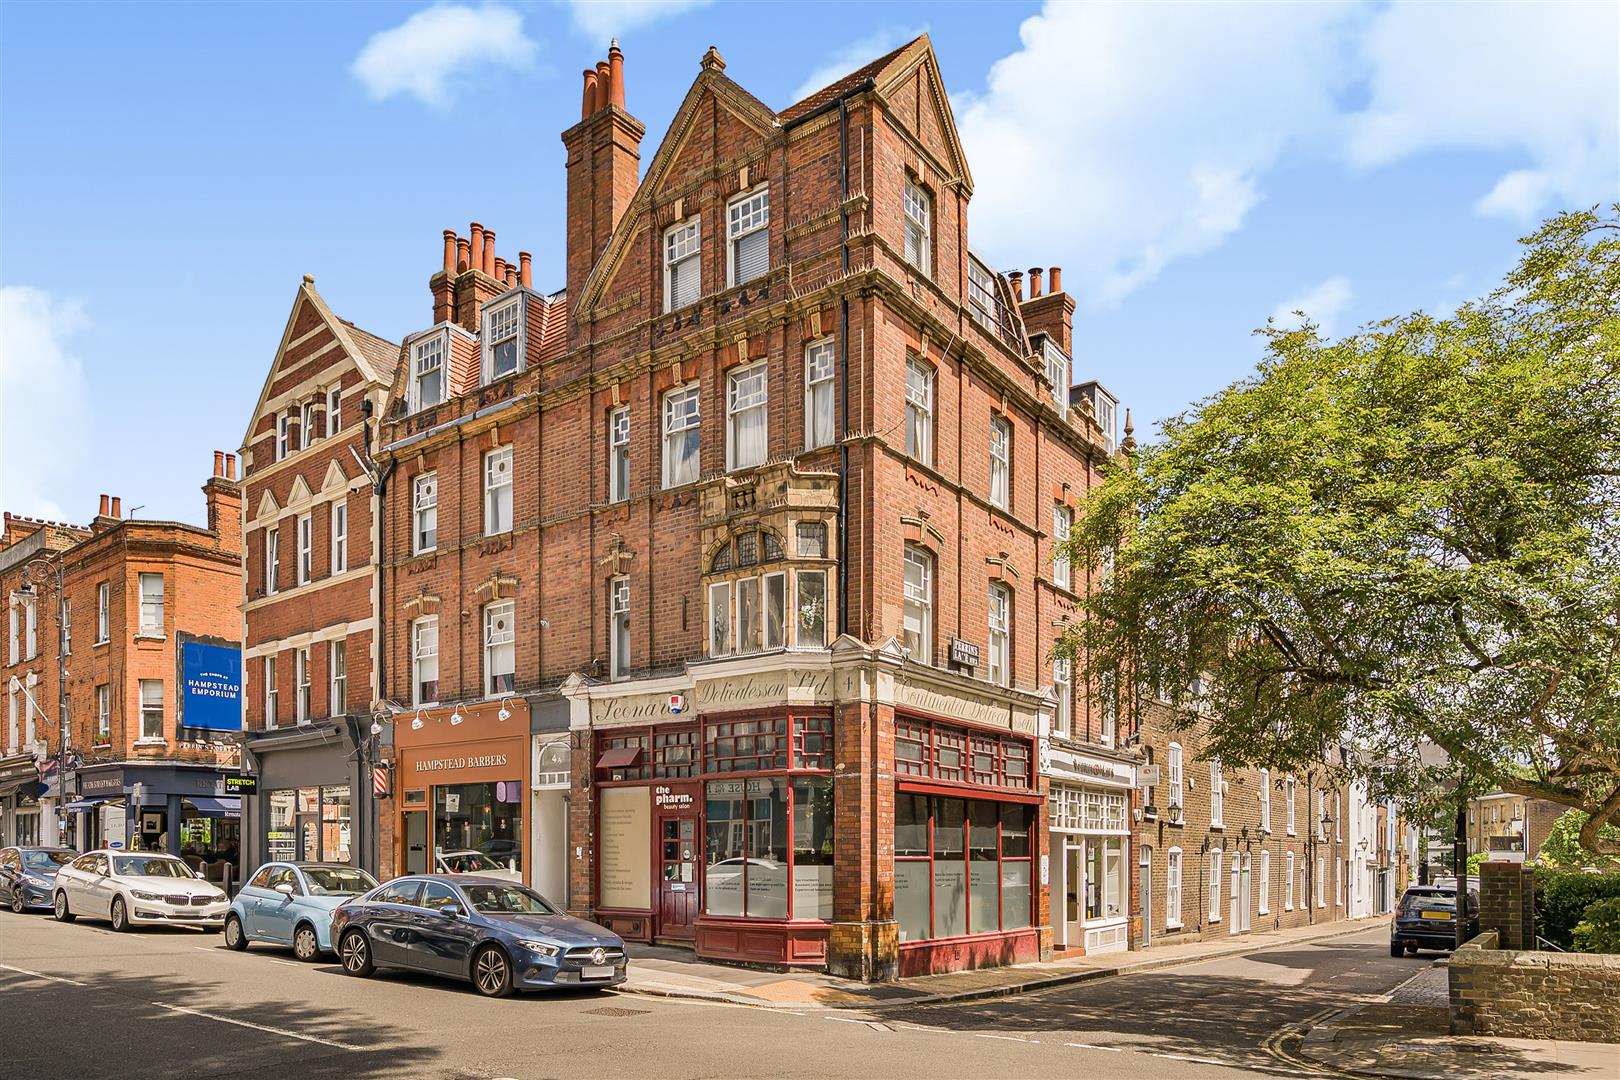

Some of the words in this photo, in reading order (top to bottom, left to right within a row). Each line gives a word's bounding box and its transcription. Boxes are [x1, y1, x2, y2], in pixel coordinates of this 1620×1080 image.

[188, 680, 240, 692] HAMPSTEAD
[192, 688, 236, 699] EMPORIUM
[970, 698, 1033, 731] Delicatssen
[416, 758, 466, 772] HAMPSTEAD
[468, 754, 507, 768] BARBERS
[656, 786, 670, 794] the
